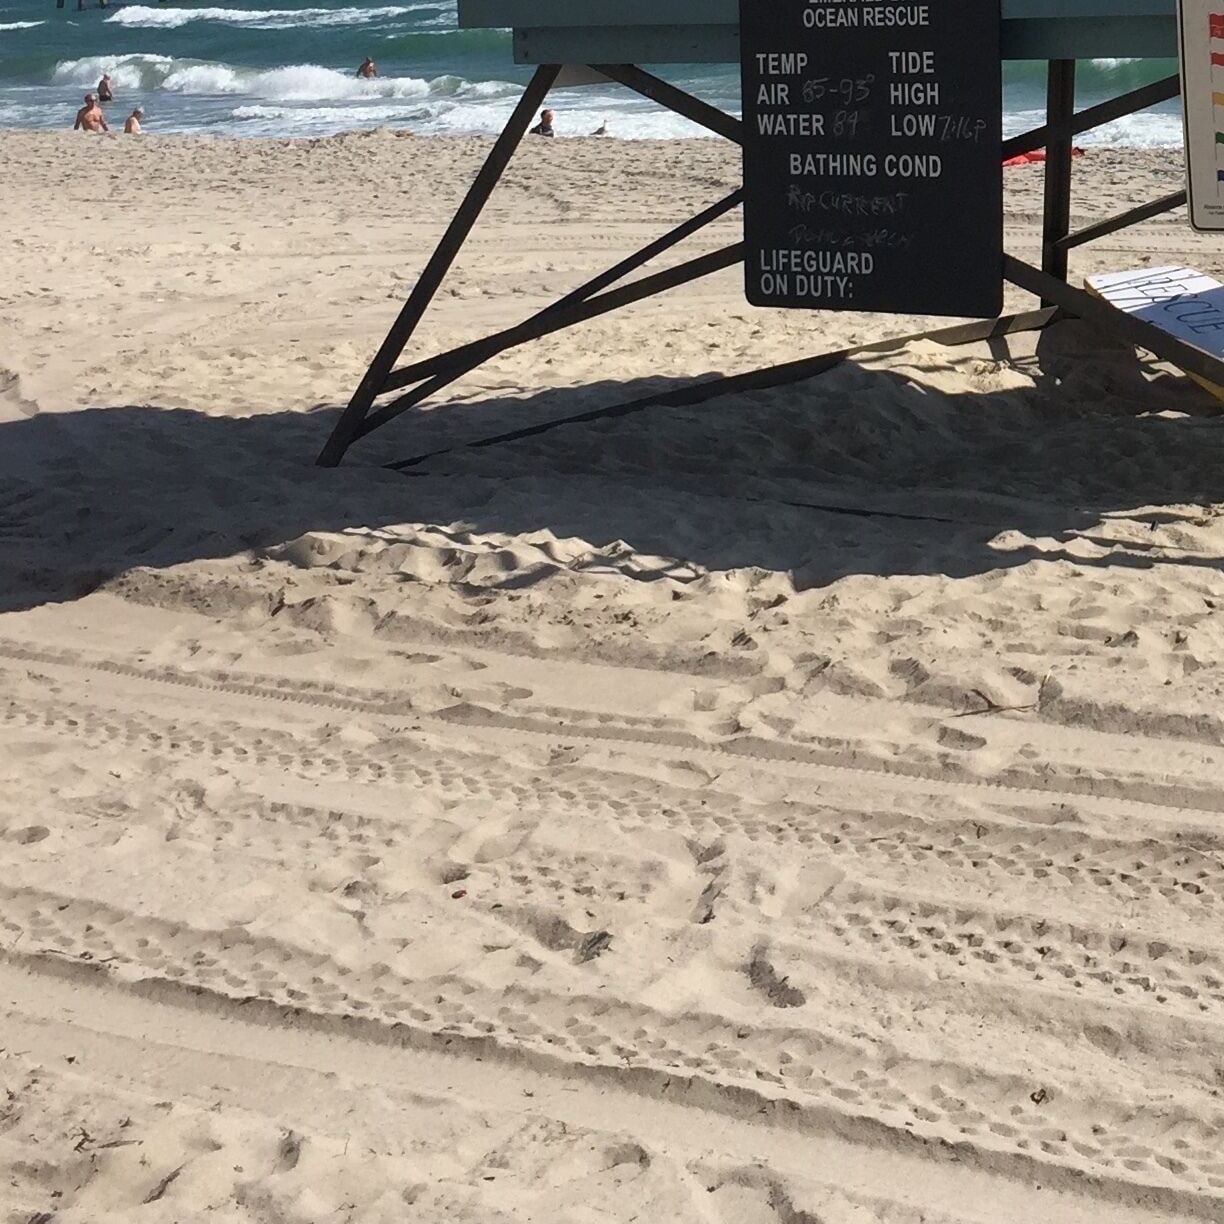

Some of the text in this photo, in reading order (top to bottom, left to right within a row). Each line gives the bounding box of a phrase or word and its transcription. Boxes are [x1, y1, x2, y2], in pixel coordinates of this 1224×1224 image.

[803, 6, 930, 28] OCEAN RESCUE
[755, 53, 808, 75] TEMP
[888, 51, 935, 74] TIDE
[756, 83, 790, 105] AIR
[890, 82, 940, 105] HIGH
[757, 114, 825, 136] WATER
[891, 114, 936, 137] LOW
[789, 153, 942, 177] BATHING COND
[760, 249, 874, 274] LIFEGUARD
[760, 273, 853, 299] ON DUTY:
